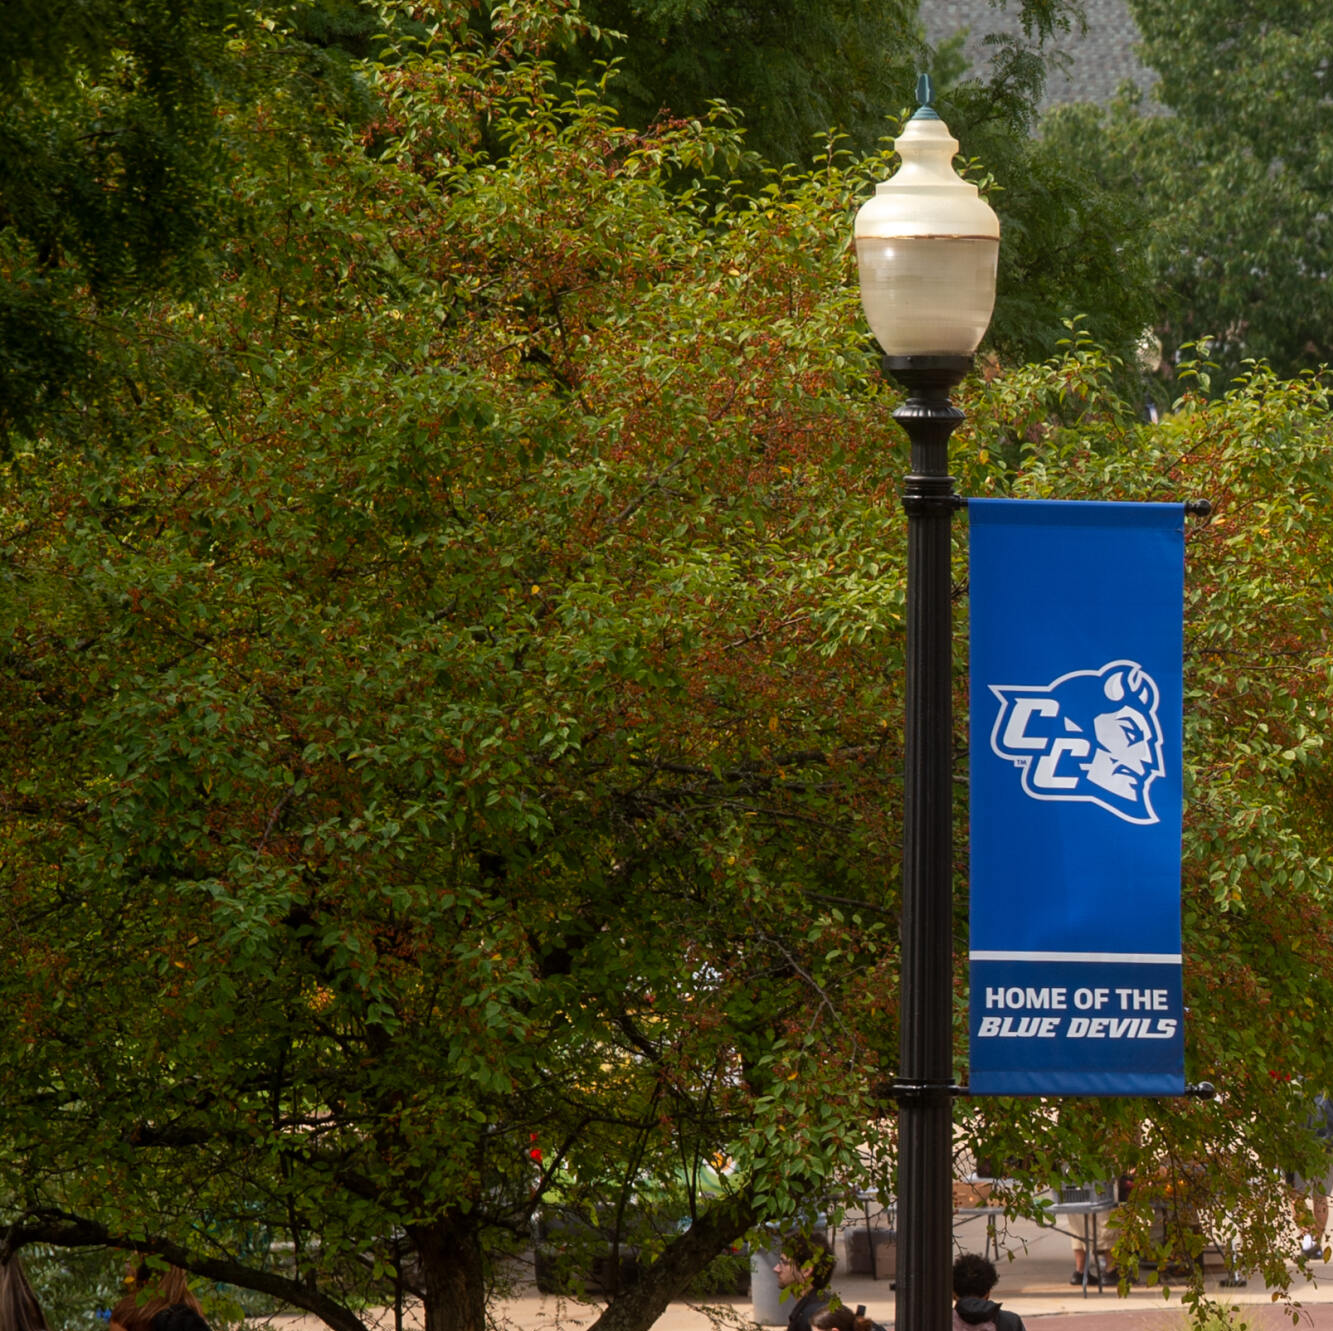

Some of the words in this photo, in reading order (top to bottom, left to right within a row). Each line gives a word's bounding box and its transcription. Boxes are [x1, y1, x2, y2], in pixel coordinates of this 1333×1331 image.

[985, 986, 1067, 1009] HOME
[1074, 988, 1110, 1010] OF
[1115, 988, 1169, 1010] THE
[977, 1016, 1061, 1038] BLUE
[1066, 1017, 1178, 1039] DEVILS
